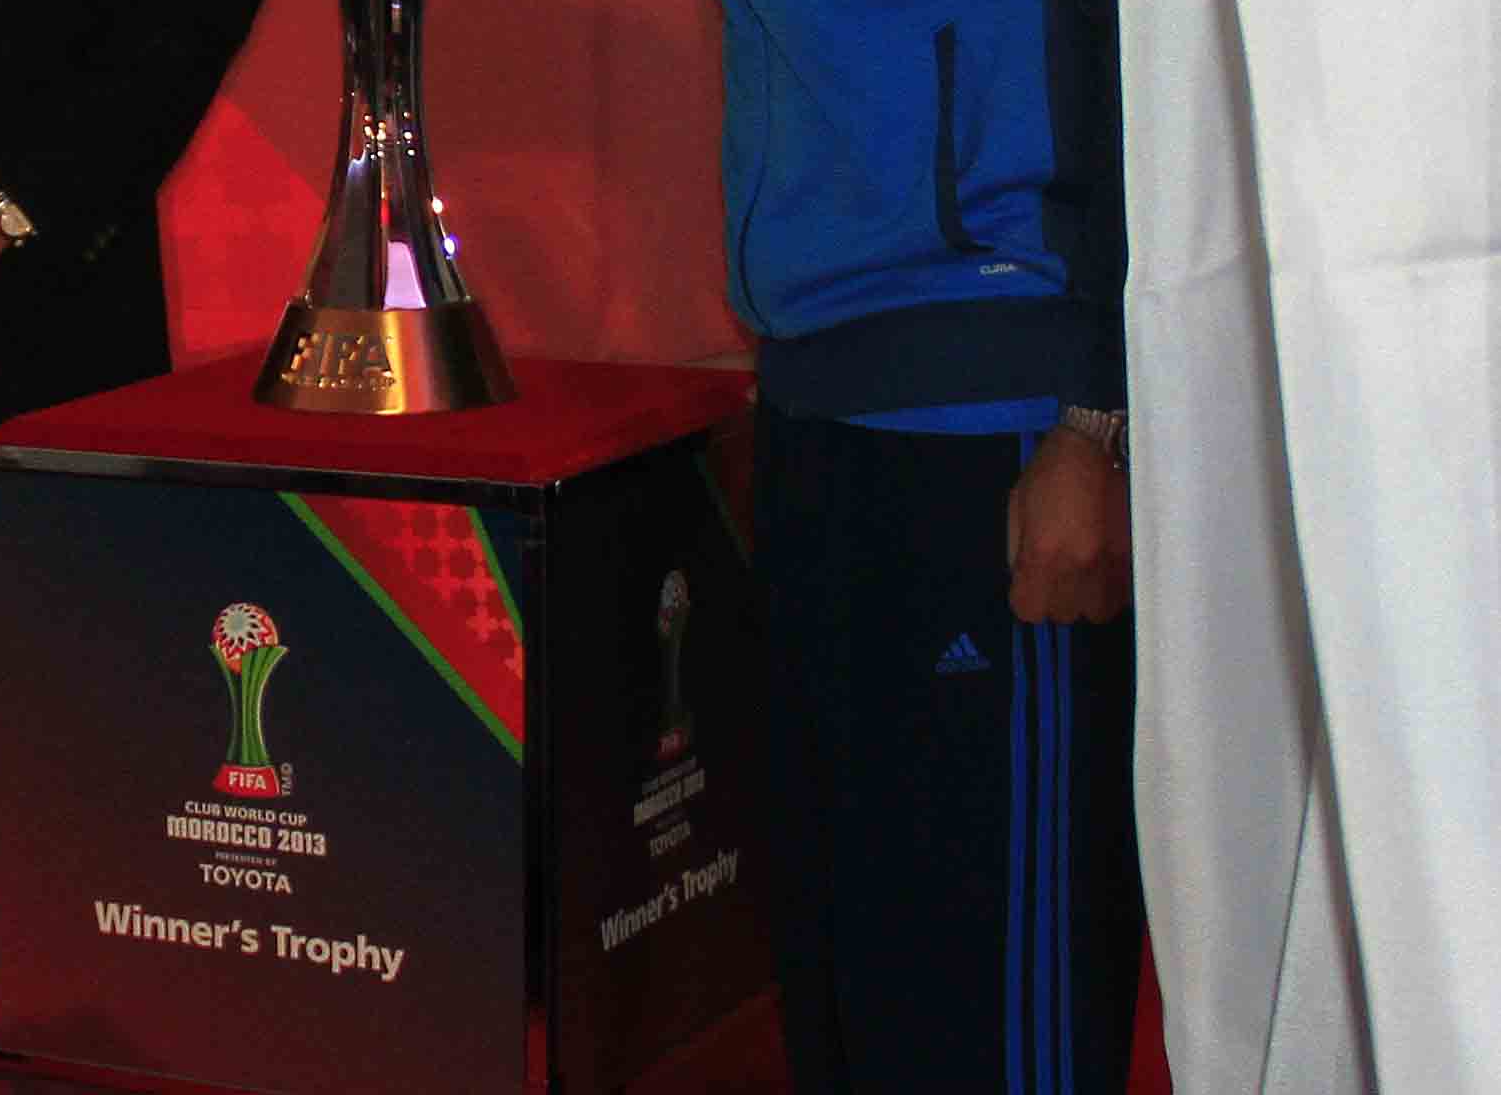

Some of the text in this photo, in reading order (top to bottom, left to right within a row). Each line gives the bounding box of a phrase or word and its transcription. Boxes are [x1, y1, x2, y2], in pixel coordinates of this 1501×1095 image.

[229, 771, 267, 791] FIFA
[185, 801, 307, 826] CLUB WORLD CUP
[167, 815, 326, 856] MOROCCO 2013
[199, 863, 293, 894] TOYOTA
[601, 848, 738, 950] Winner's Trophy
[95, 900, 404, 981] Winner's Trophy
